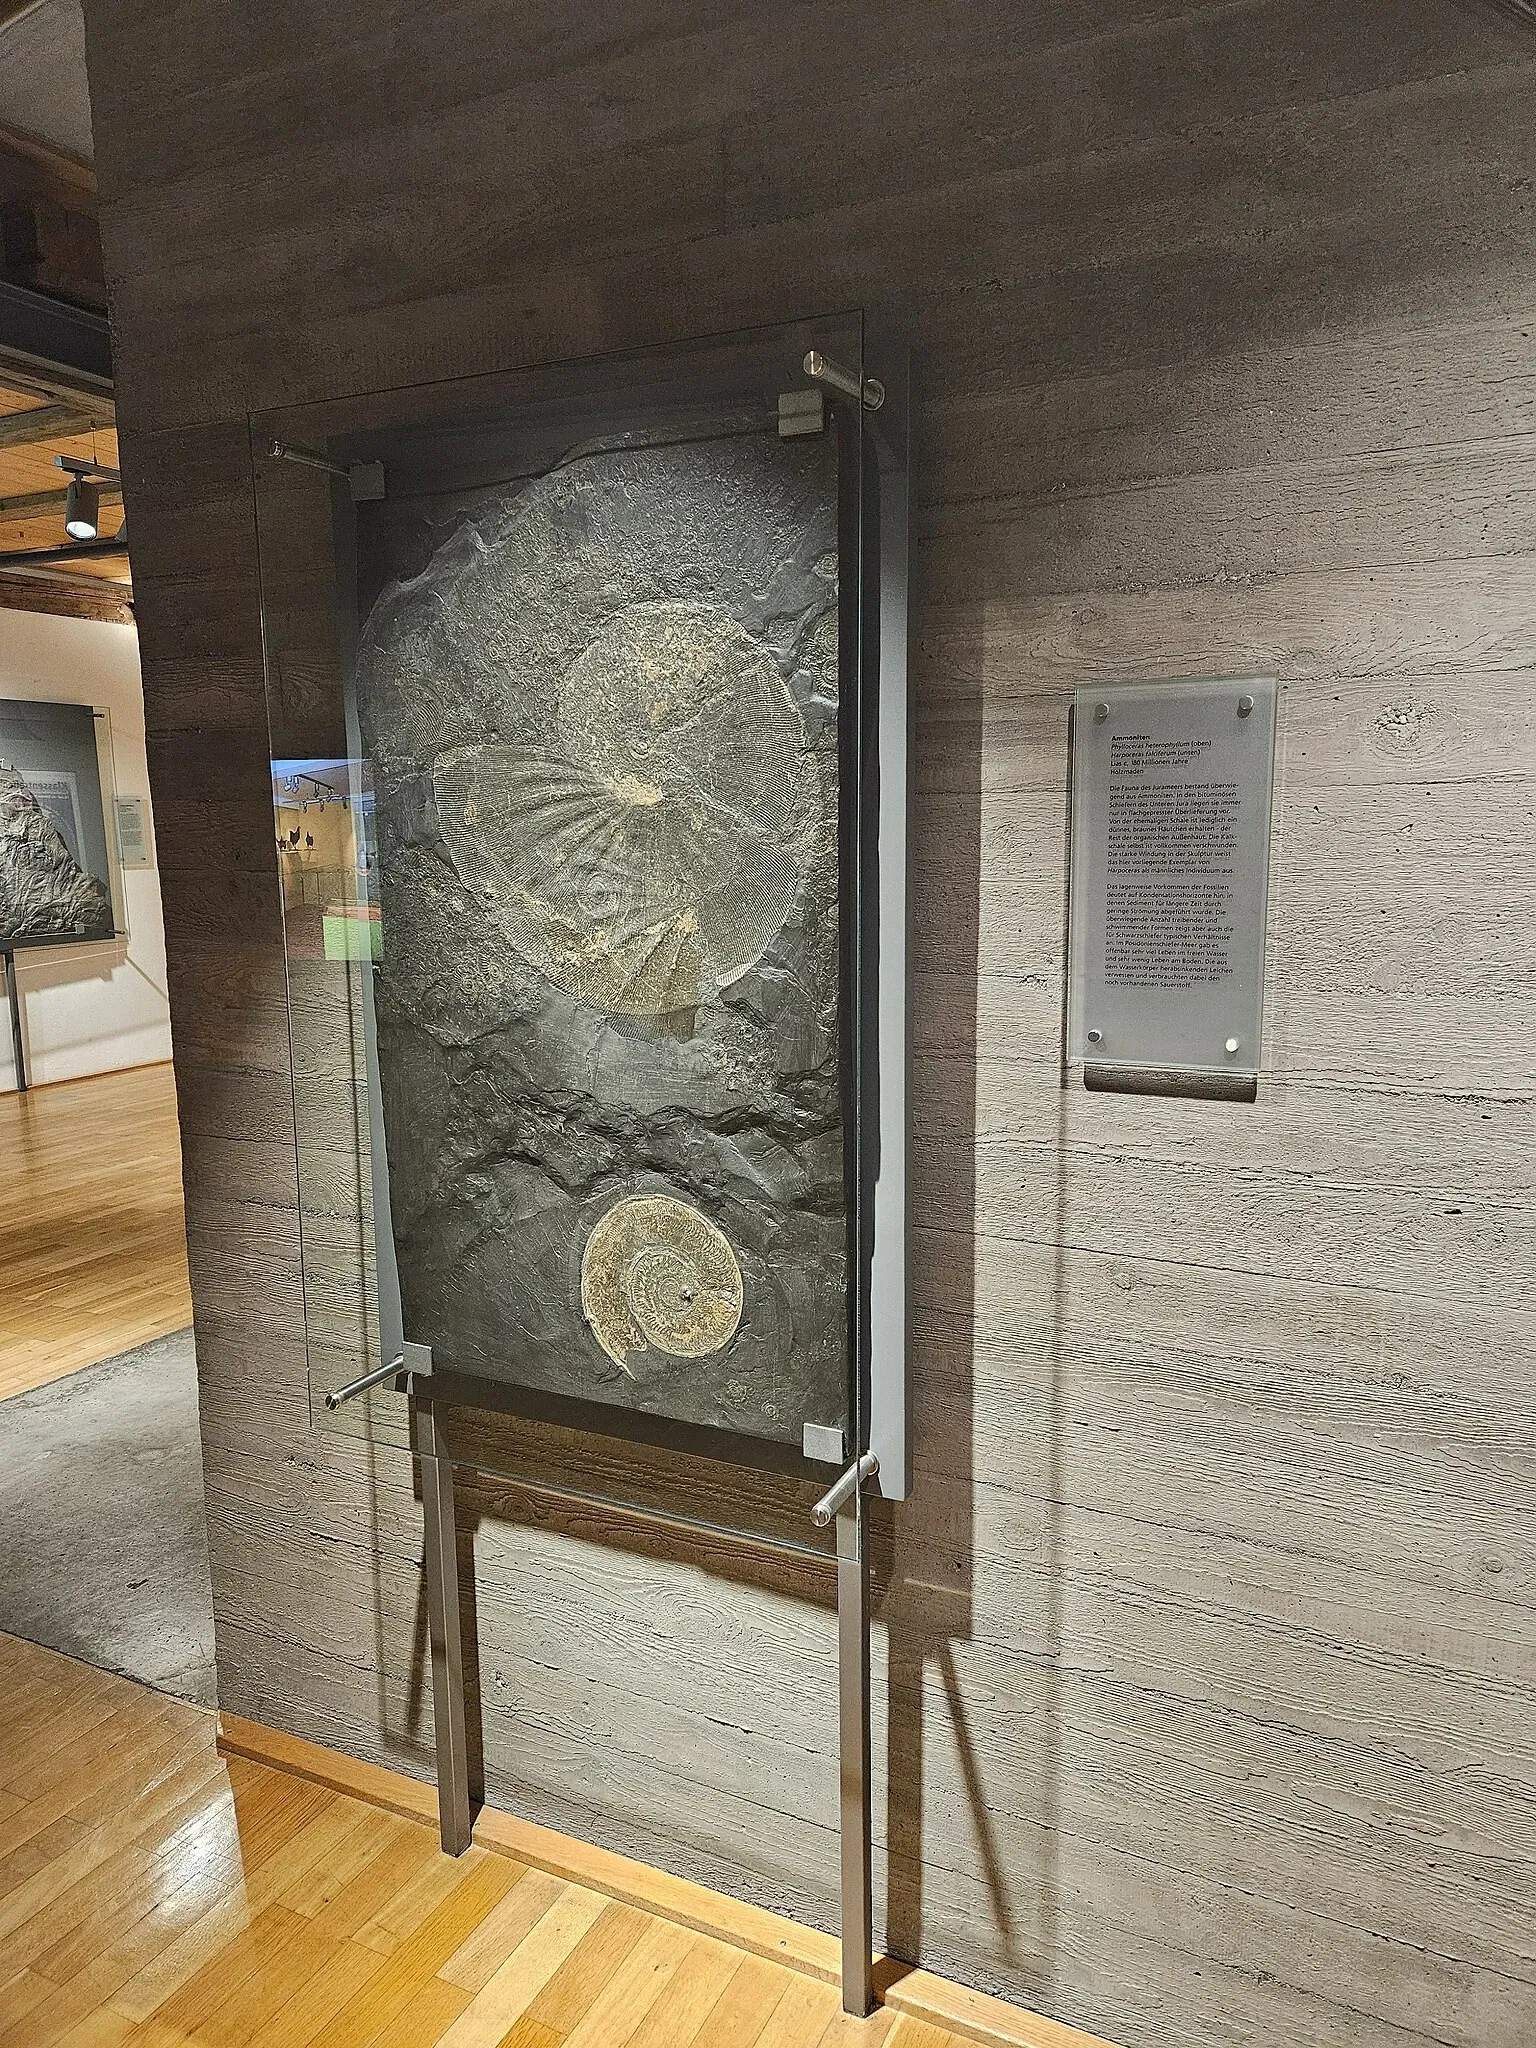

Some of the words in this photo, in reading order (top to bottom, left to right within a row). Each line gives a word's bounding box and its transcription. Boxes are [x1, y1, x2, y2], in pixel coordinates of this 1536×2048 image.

[1109, 793, 1125, 801] gend
[1128, 809, 1174, 817] flachgepresster
[1133, 817, 1168, 825] ehemaligen
[1169, 816, 1189, 824] Schale
[1199, 816, 1226, 824] lediglich
[1133, 834, 1169, 842] organischen
[1138, 850, 1167, 858] Windung
[1166, 900, 1189, 908] längere
[1130, 908, 1159, 916] Strömung
[1160, 908, 1191, 916] abgeführt
[1163, 933, 1193, 941] typischen
[1193, 933, 1231, 941] Verhältnisse
[1119, 964, 1159, 972] Wasserkörper
[1160, 965, 1208, 973] herabsinkenden
